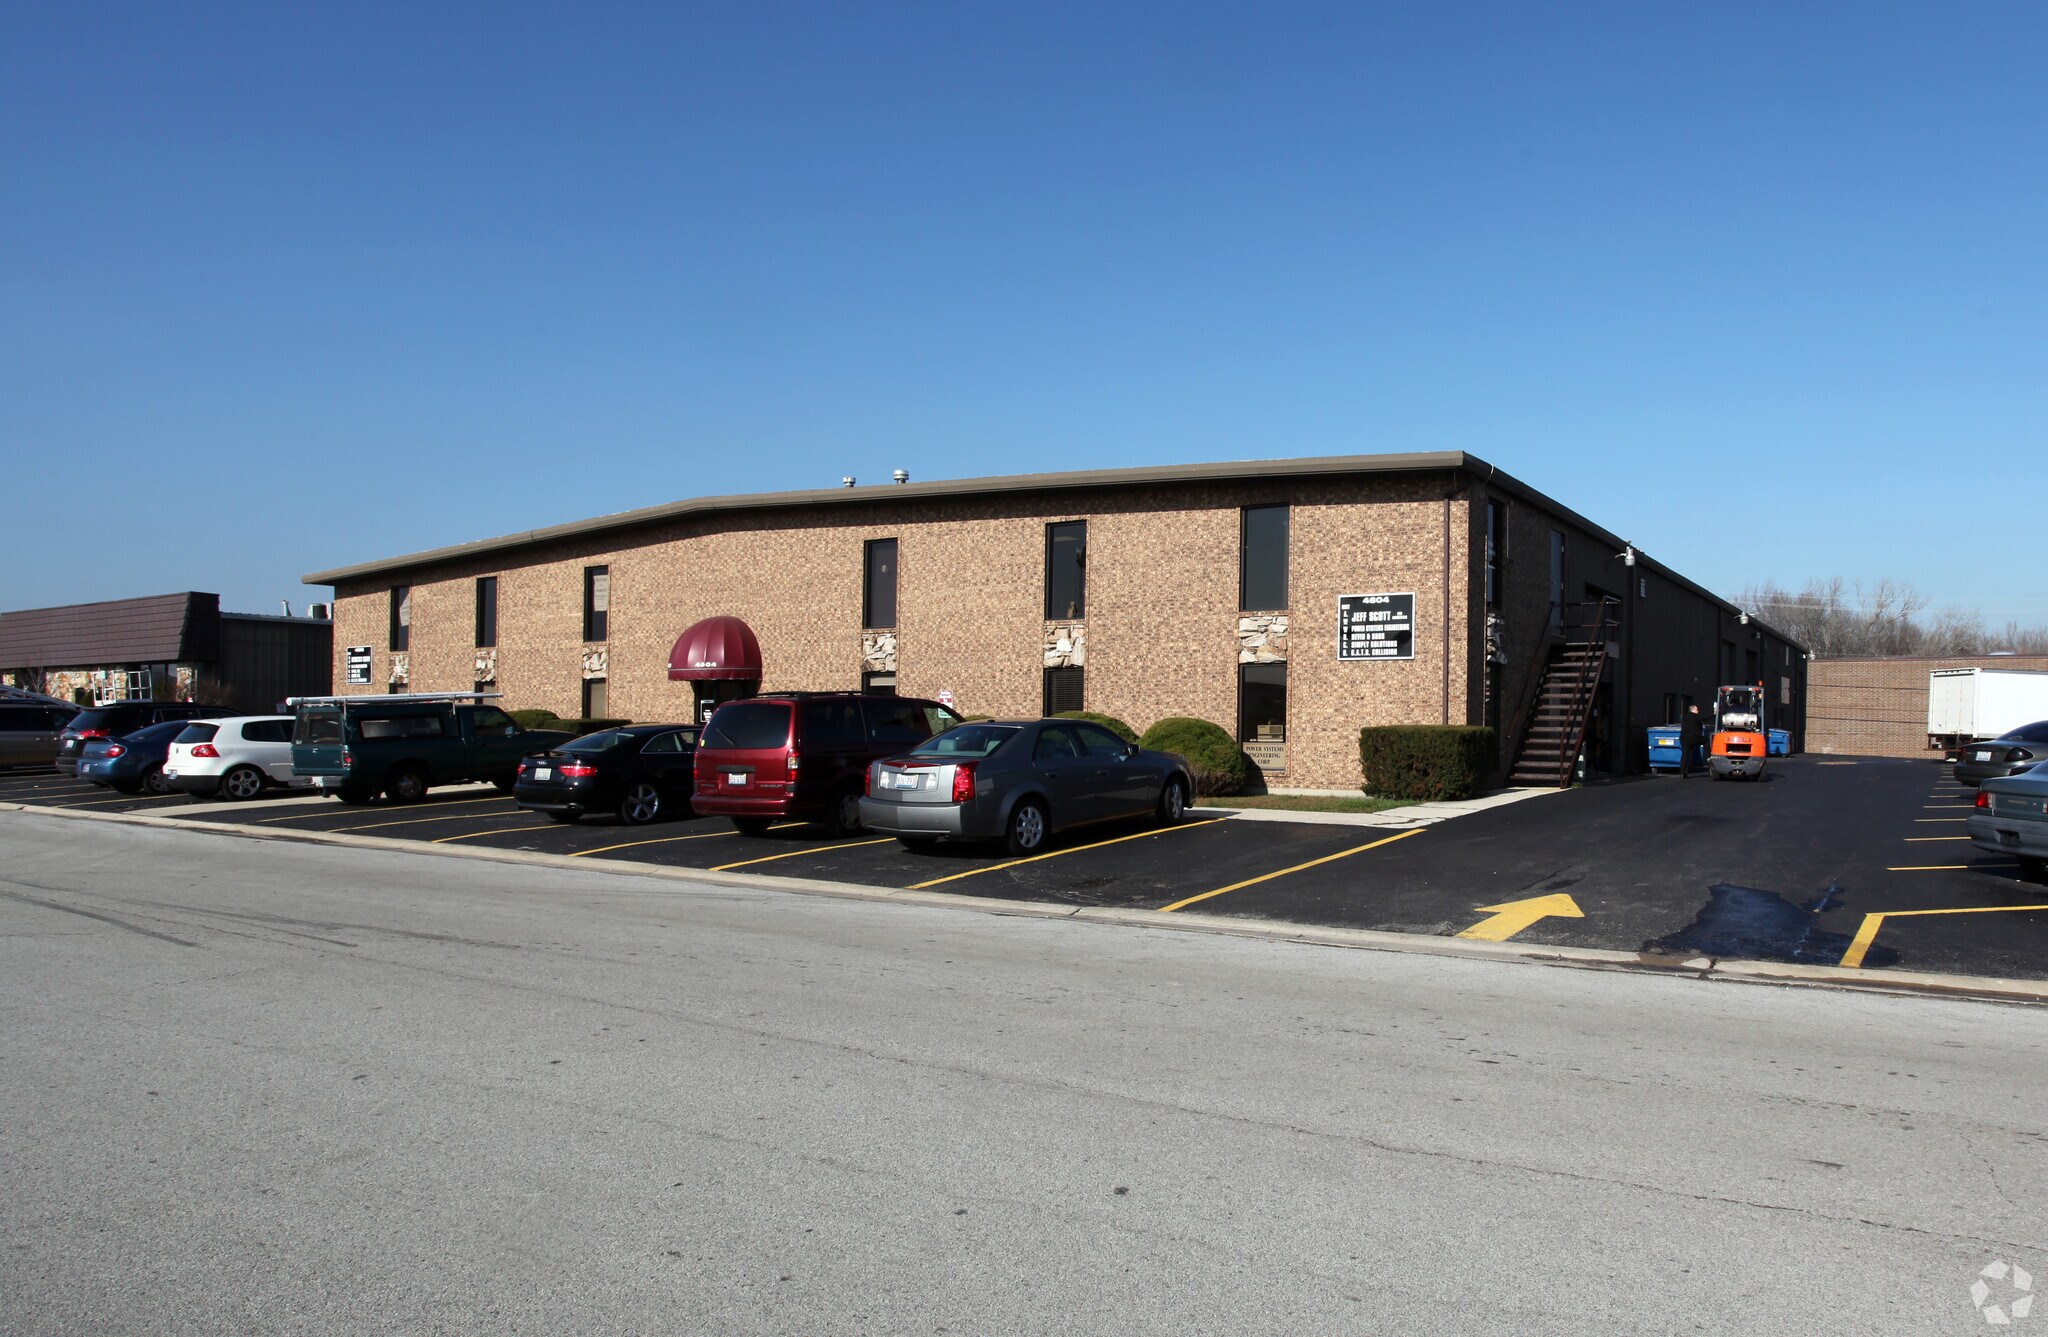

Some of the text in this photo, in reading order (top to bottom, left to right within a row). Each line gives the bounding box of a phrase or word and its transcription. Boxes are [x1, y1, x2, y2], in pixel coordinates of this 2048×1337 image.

[1362, 596, 1390, 604] 4604
[1351, 611, 1367, 622] JEFF
[1368, 611, 1391, 622] SCOTT
